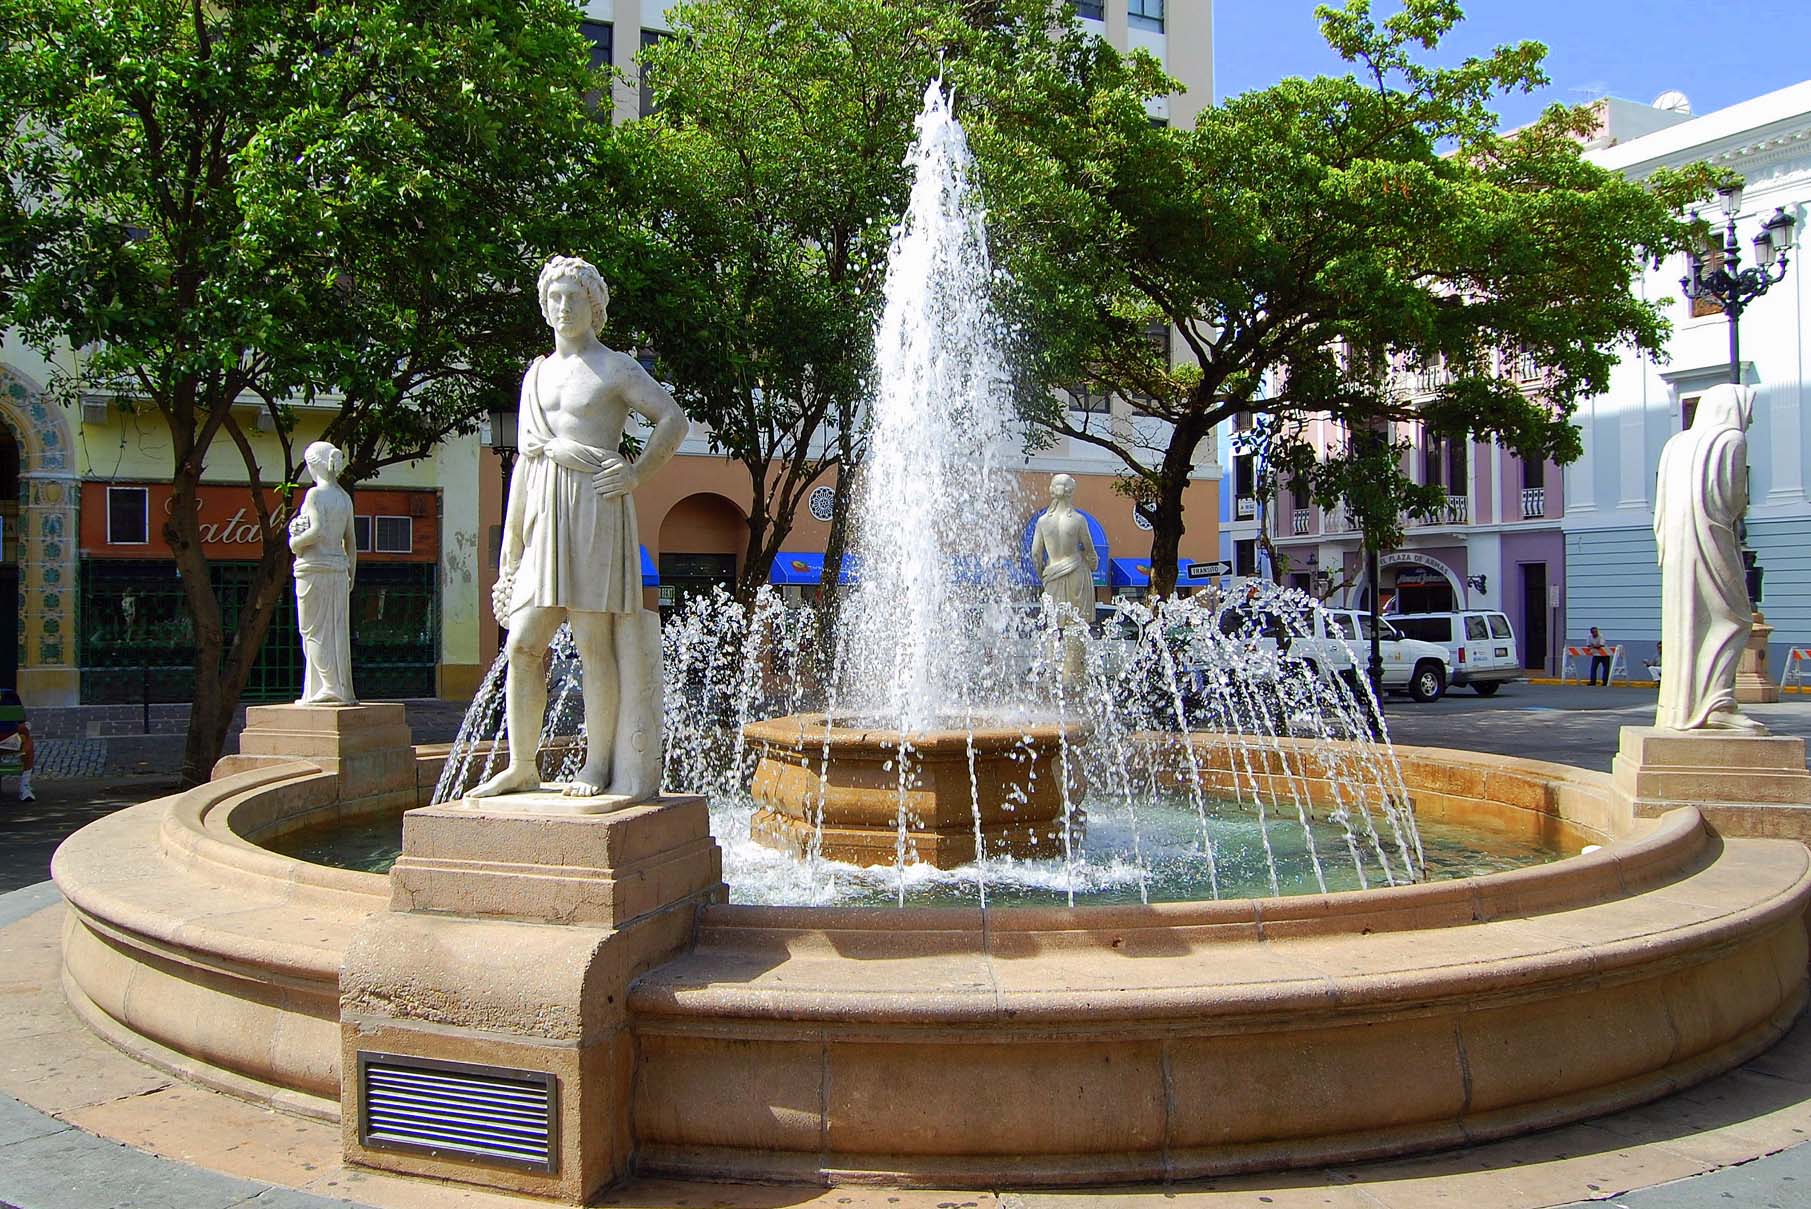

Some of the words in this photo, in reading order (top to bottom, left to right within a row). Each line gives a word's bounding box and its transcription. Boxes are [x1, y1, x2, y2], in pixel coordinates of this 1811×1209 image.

[1192, 566, 1219, 575] TRANSITO
[1388, 554, 1411, 562] PLAZA
[1425, 557, 1448, 574] ARMAS
